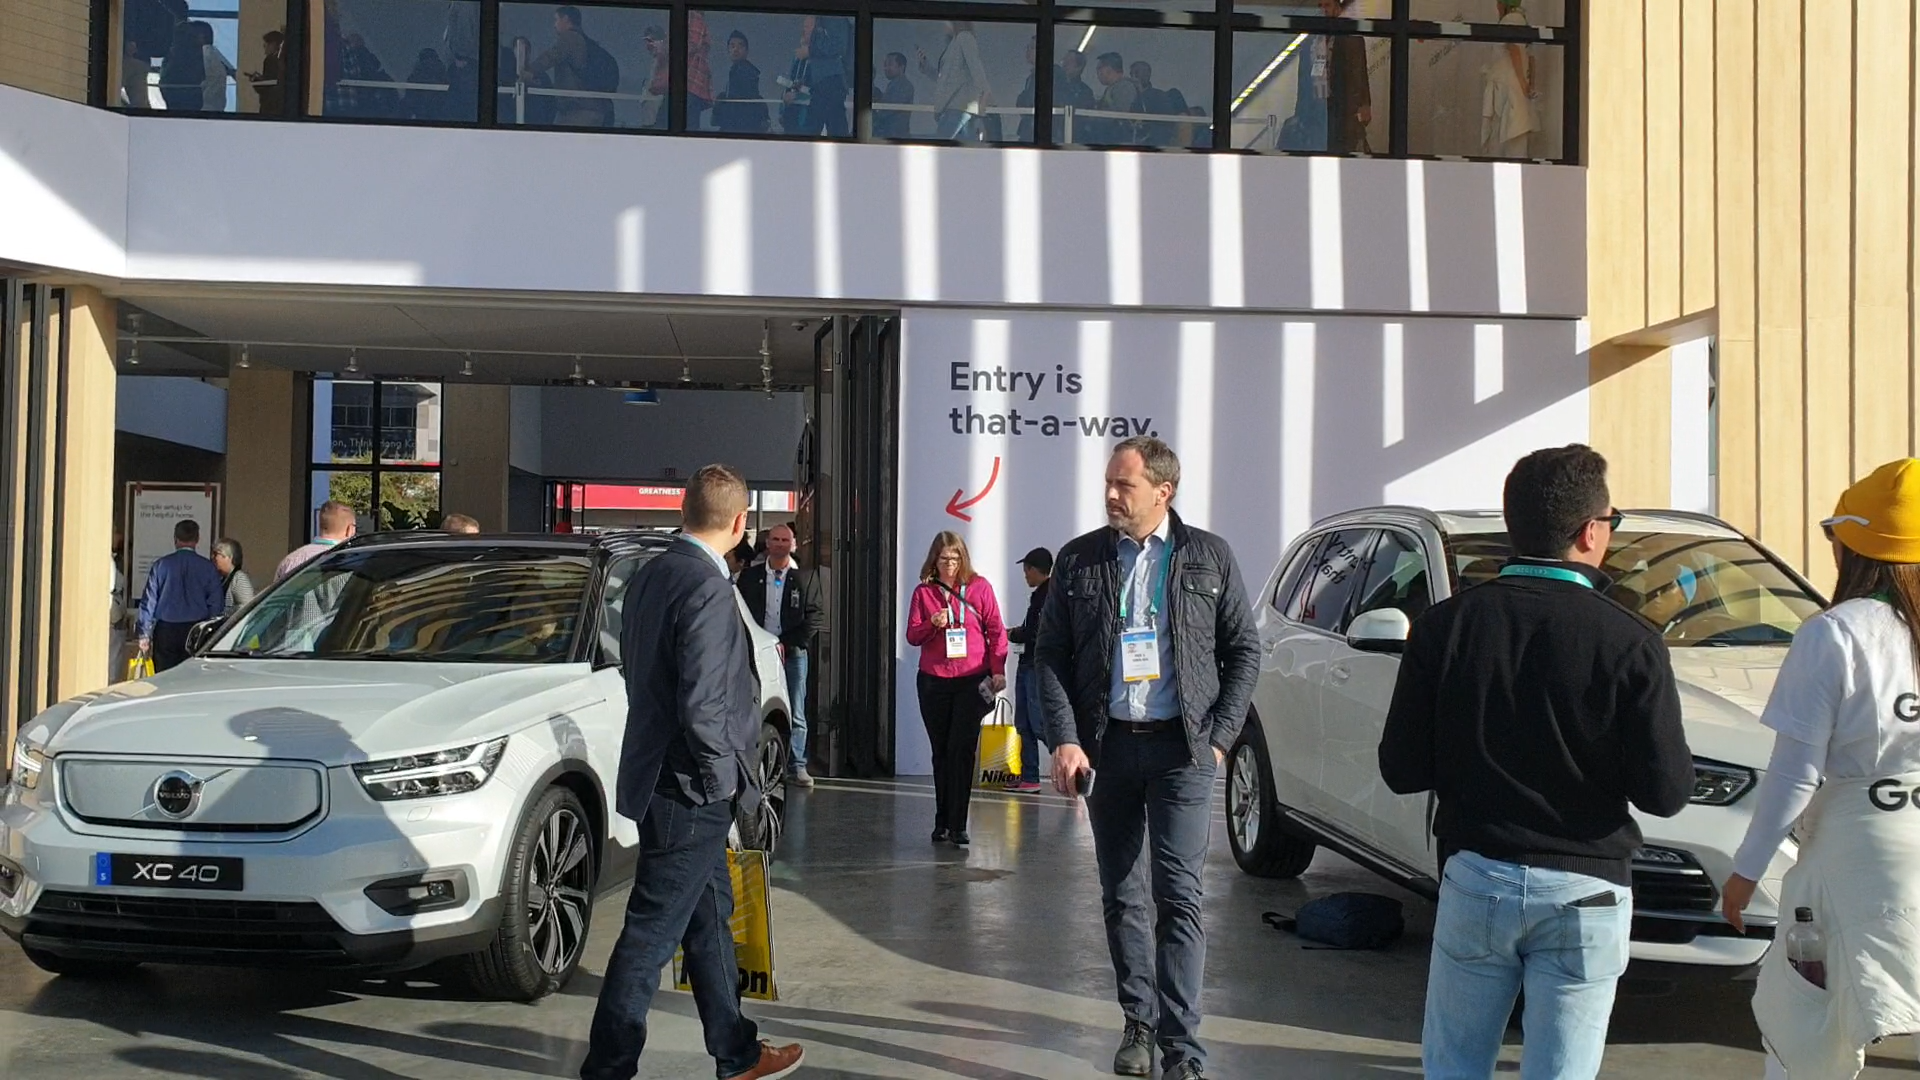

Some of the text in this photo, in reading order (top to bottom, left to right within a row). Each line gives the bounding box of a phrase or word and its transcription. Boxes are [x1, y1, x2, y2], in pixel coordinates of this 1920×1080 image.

[951, 362, 1083, 401] Entry is
[949, 405, 1159, 437] that-a-way.
[638, 487, 681, 496] GREATNESS
[132, 862, 220, 882] XC 40
